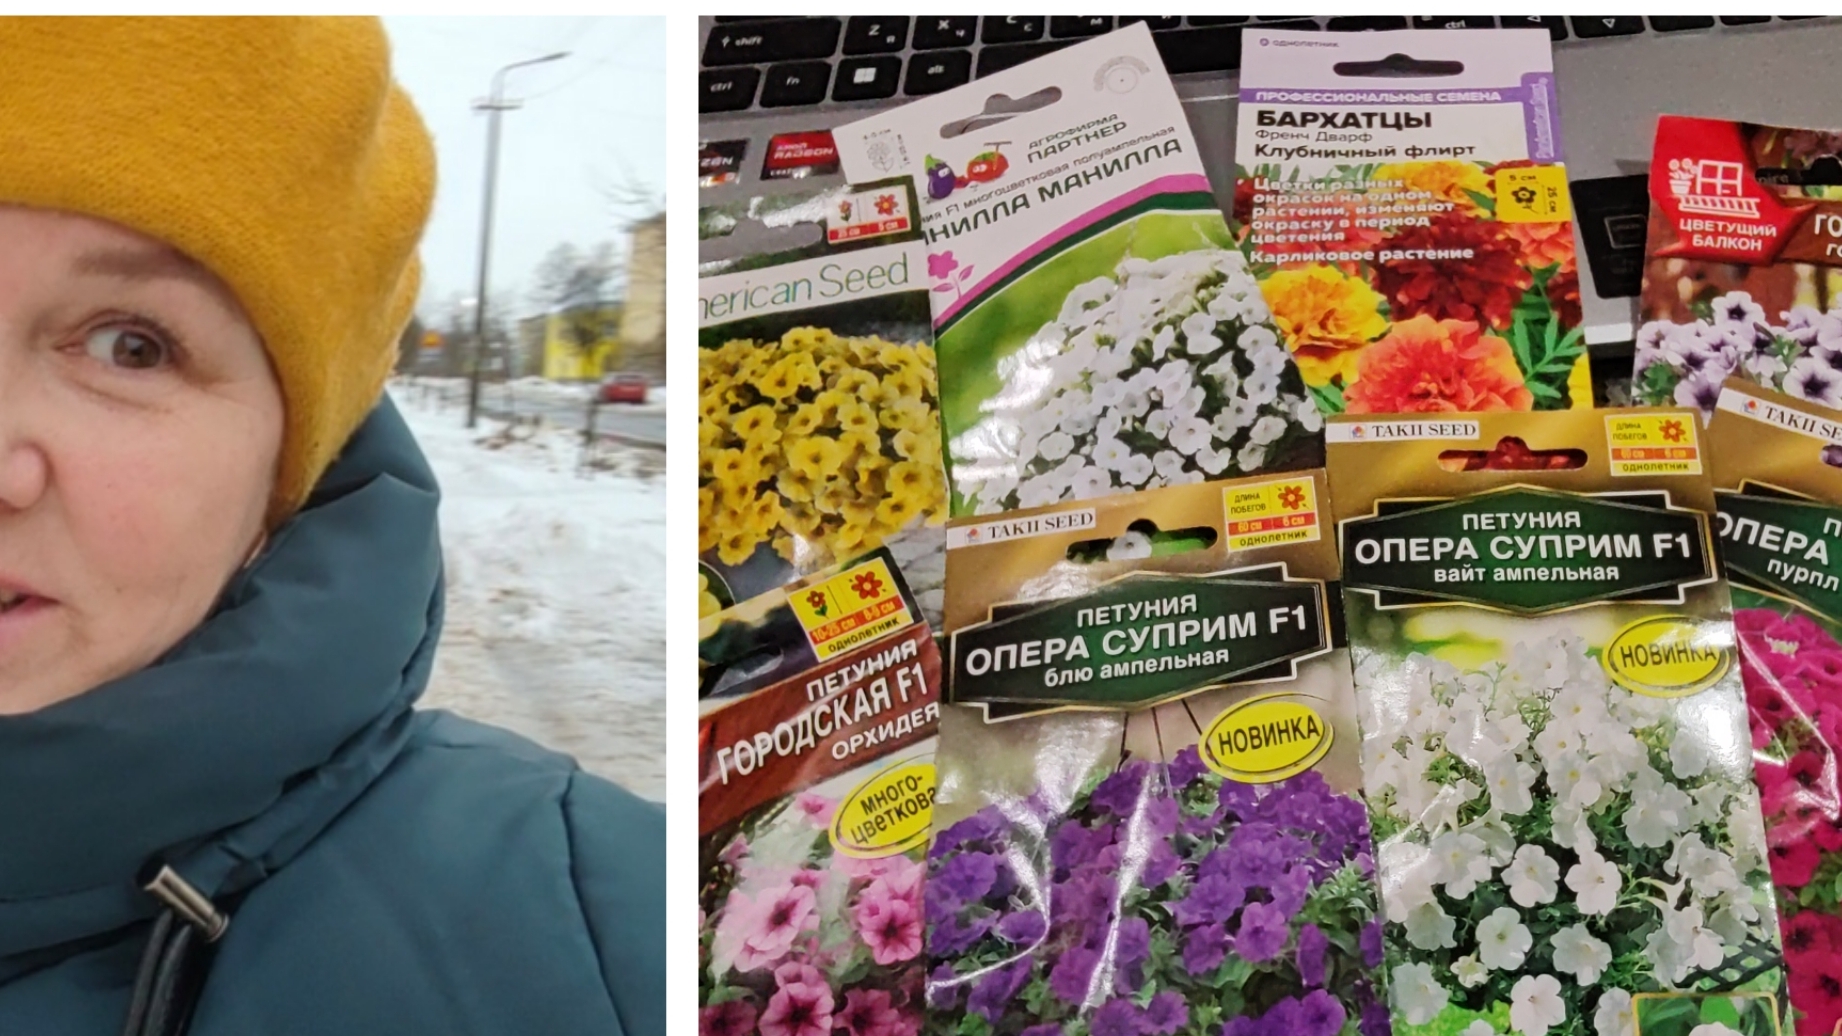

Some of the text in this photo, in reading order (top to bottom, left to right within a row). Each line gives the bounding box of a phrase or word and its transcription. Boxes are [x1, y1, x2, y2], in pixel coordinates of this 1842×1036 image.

[1255, 90, 1502, 104] ПРОФЕССИОНАЛЬНЫЕ СЕМЕНА
[1256, 110, 1432, 131] БАРХАТЦЫ
[1028, 113, 1119, 151] АГРОФИРМА
[1255, 129, 1373, 144] Френч Дварф
[1027, 121, 1128, 164] ПАРТНЕР
[1255, 144, 1476, 161] Клубничный флирт
[1037, 138, 1183, 204] МАНИЛЛА
[1254, 177, 1404, 193] Цветки разных
[1253, 190, 1432, 206] окрасок на одном
[1355, 203, 1454, 215] изменяют
[1251, 218, 1334, 233] окраску
[1355, 216, 1431, 231] период
[1680, 218, 1777, 238] ЦВЕТУЩИЙ
[1251, 232, 1345, 245] цветения
[1692, 233, 1762, 251] БАЛКОН
[1250, 248, 1474, 264] Карликовое растение
[819, 251, 909, 298] Seed
[1616, 422, 1642, 431] ДЛИНА
[1765, 405, 1816, 433] TAKII
[1372, 423, 1476, 438] TAKII SEED
[1612, 432, 1648, 441] ПОБЕГОВ
[1622, 462, 1690, 473] однолетник
[1234, 491, 1261, 504] ДЛИНА
[1230, 502, 1266, 516] ПОБЕГОВ
[988, 511, 1093, 540] TAKII SEED
[1462, 511, 1581, 531] ПЕТУНИЯ
[1239, 530, 1308, 548] однолетник
[1355, 532, 1692, 565] ОПЕРА СУПРИМ F1
[1434, 564, 1620, 583] вайт ампельная
[1767, 559, 1840, 592] пурпл
[1077, 594, 1198, 629] ПЕТУНИЯ
[828, 617, 900, 653] однолетник
[966, 605, 1306, 676] ОПЕРА СУПРИМ F1
[1619, 640, 1721, 670] НОВИНКА
[807, 638, 918, 702] ПЕТУНИЯ
[1044, 648, 1230, 688] блю ампельная
[716, 663, 928, 785] ГОРОДСКАЯ F1
[831, 701, 940, 761] ОРХИДЕЯ
[1218, 715, 1321, 757] НОВИНКА
